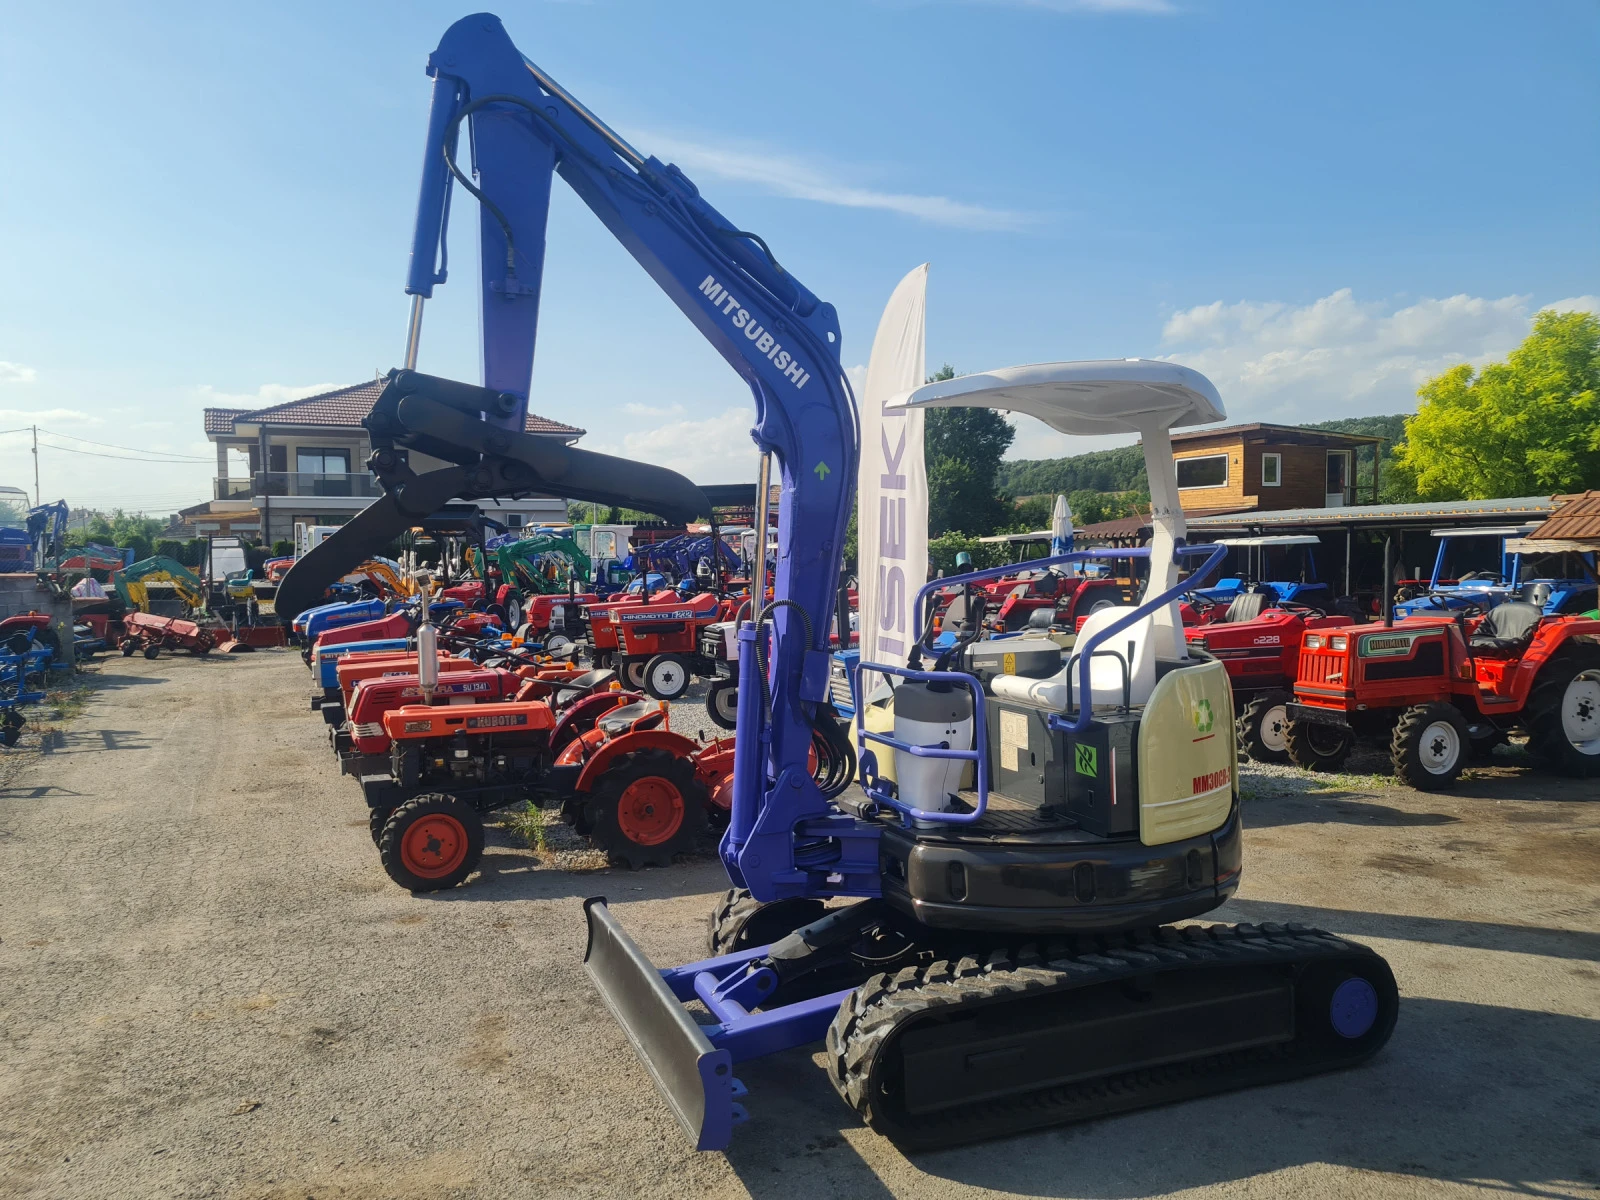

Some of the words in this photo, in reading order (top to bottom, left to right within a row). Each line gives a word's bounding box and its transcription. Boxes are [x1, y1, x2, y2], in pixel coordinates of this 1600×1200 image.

[698, 275, 810, 389] MITSUBISHI
[878, 400, 906, 656] ISEKI
[1254, 635, 1280, 644] D228
[473, 683, 487, 691] 1341
[477, 715, 517, 727] KUBOTA
